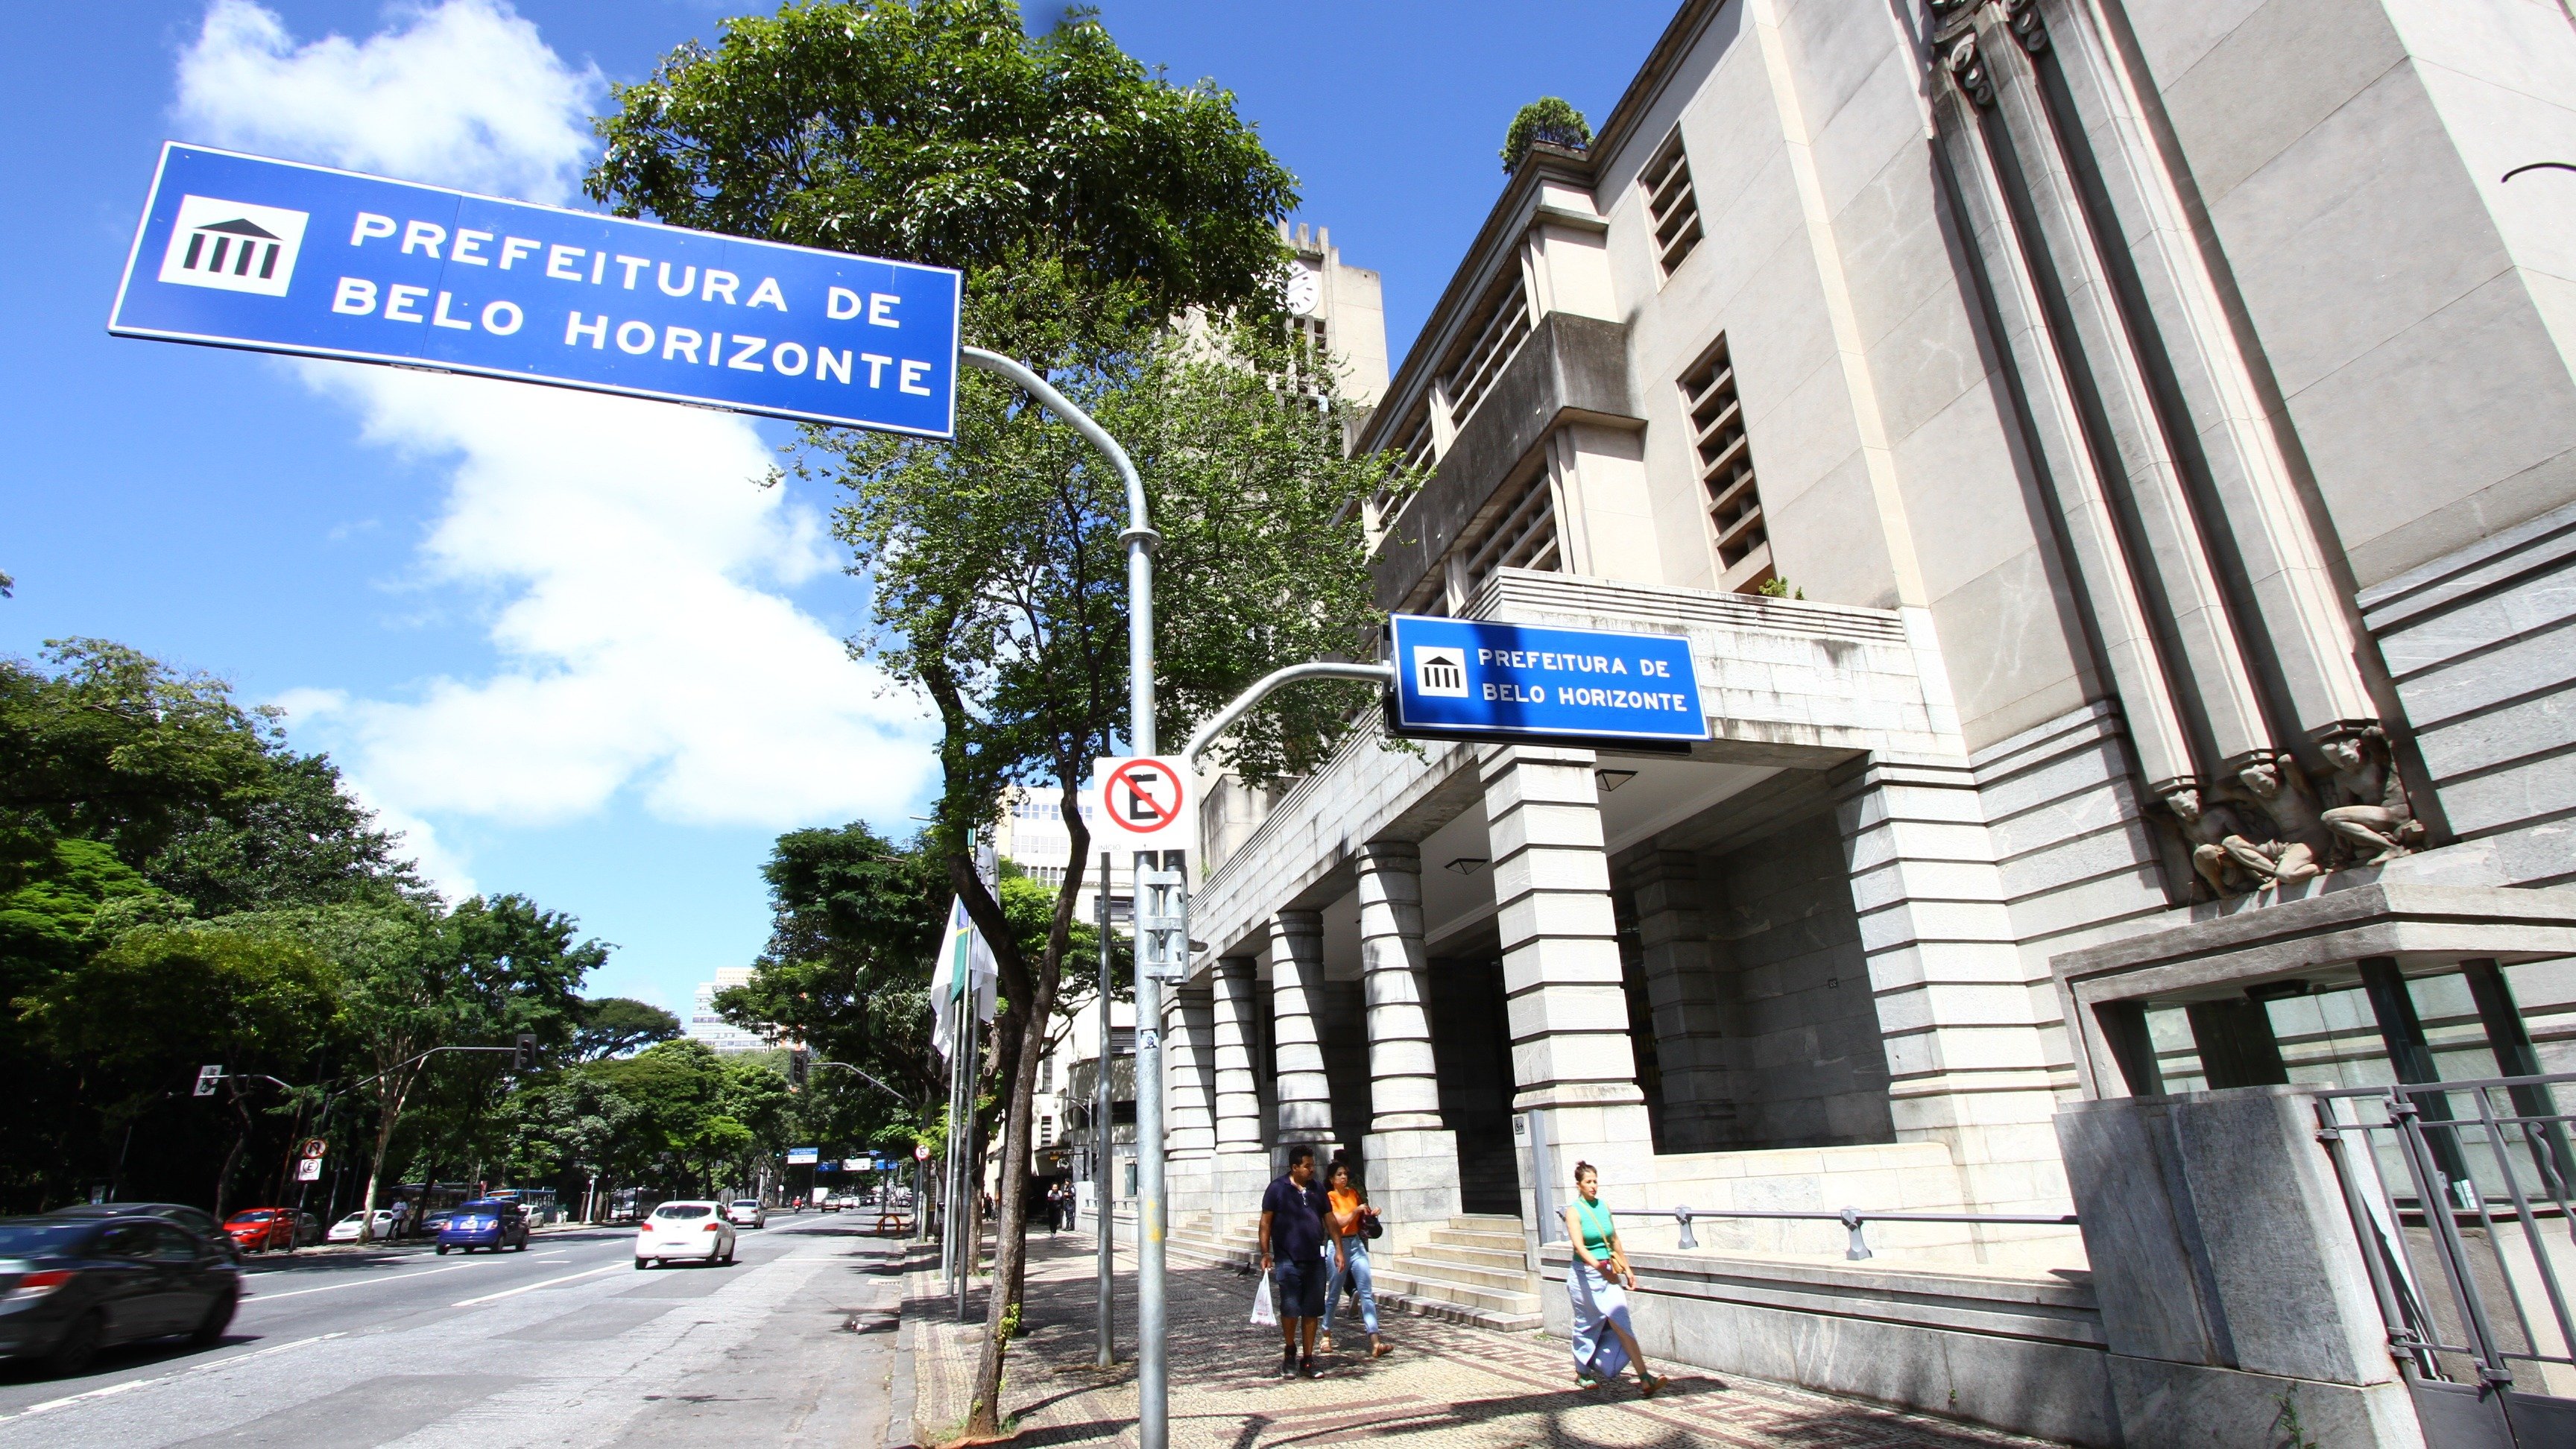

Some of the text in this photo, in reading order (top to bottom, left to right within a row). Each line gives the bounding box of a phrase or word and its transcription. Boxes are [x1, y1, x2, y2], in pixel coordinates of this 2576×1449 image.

[350, 211, 901, 329] PREFEITURA DE
[331, 276, 932, 397] BELO HORIZONTE
[1477, 648, 1670, 678] PREFEITURA DE
[1483, 683, 1688, 712] BELO HORIZONTE
[1129, 774, 1158, 820] E
